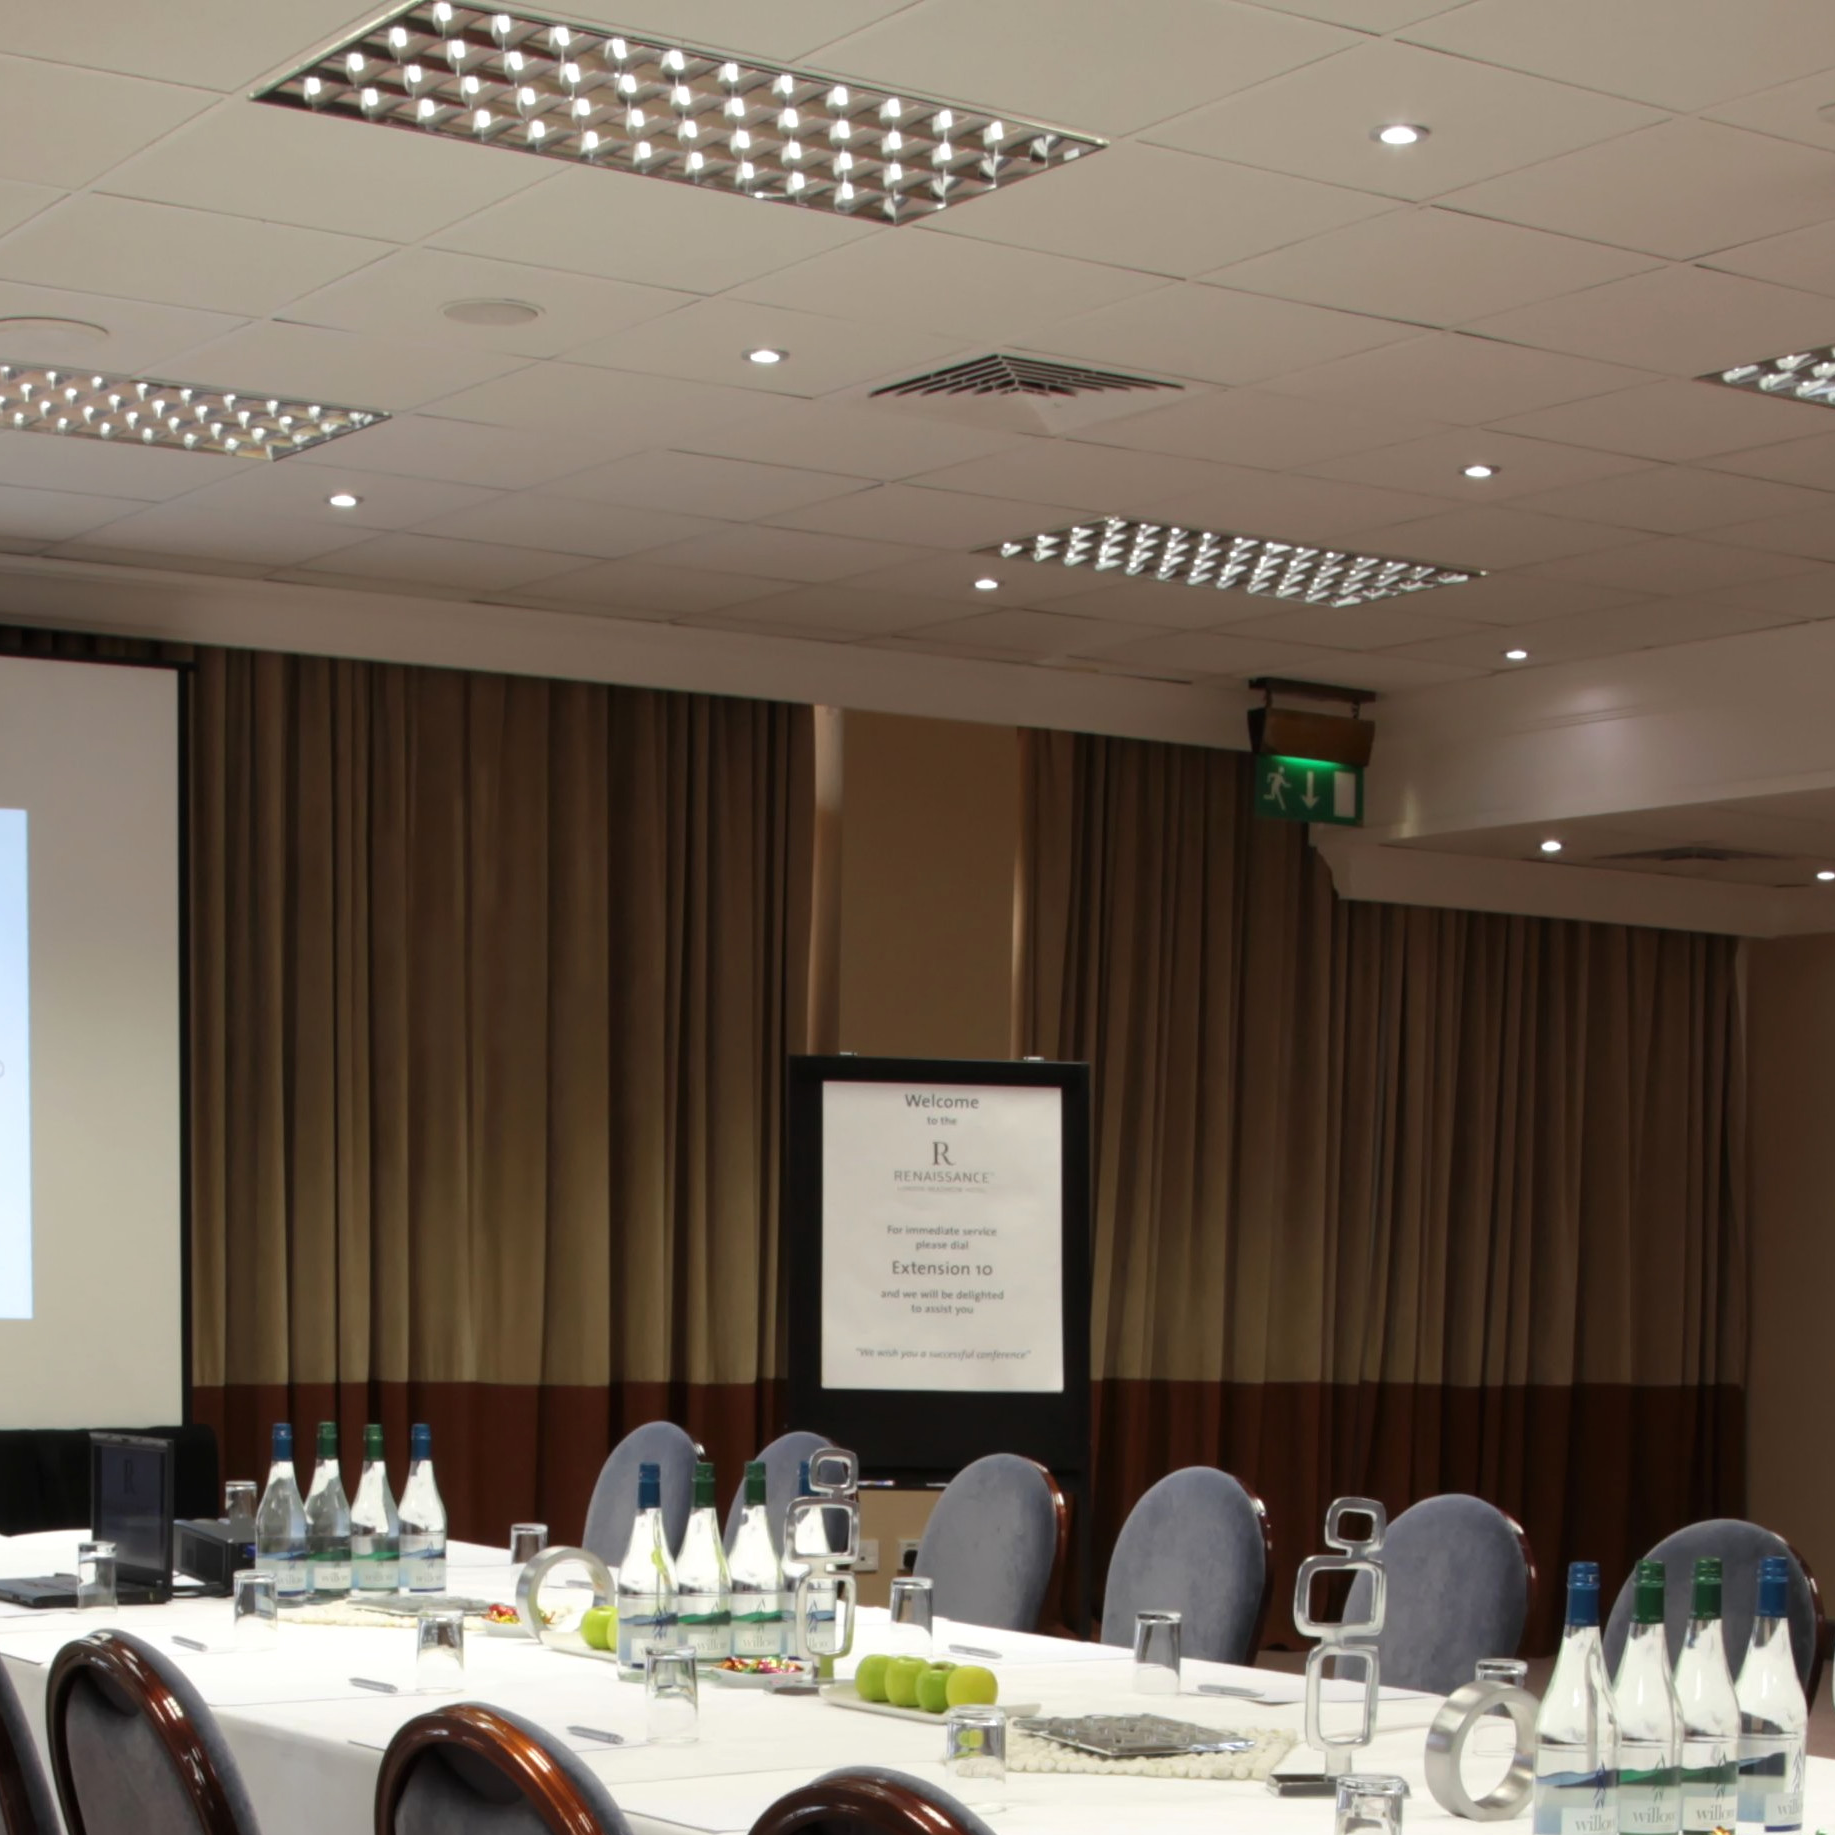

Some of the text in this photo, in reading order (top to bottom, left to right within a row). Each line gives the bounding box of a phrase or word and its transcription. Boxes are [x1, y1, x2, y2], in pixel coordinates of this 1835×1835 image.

[904, 1093, 980, 1110] Welcome
[927, 1116, 957, 1126] to the
[931, 1141, 956, 1166] R
[887, 1225, 997, 1237] For immediate service
[915, 1240, 969, 1252] please dial
[892, 1261, 993, 1277] Extension 10
[880, 1289, 1005, 1303] and we will be delighted
[911, 1303, 975, 1317] to assist you
[876, 1348, 898, 1359] wish
[900, 1350, 919, 1361] you
[928, 1347, 975, 1361] successful
